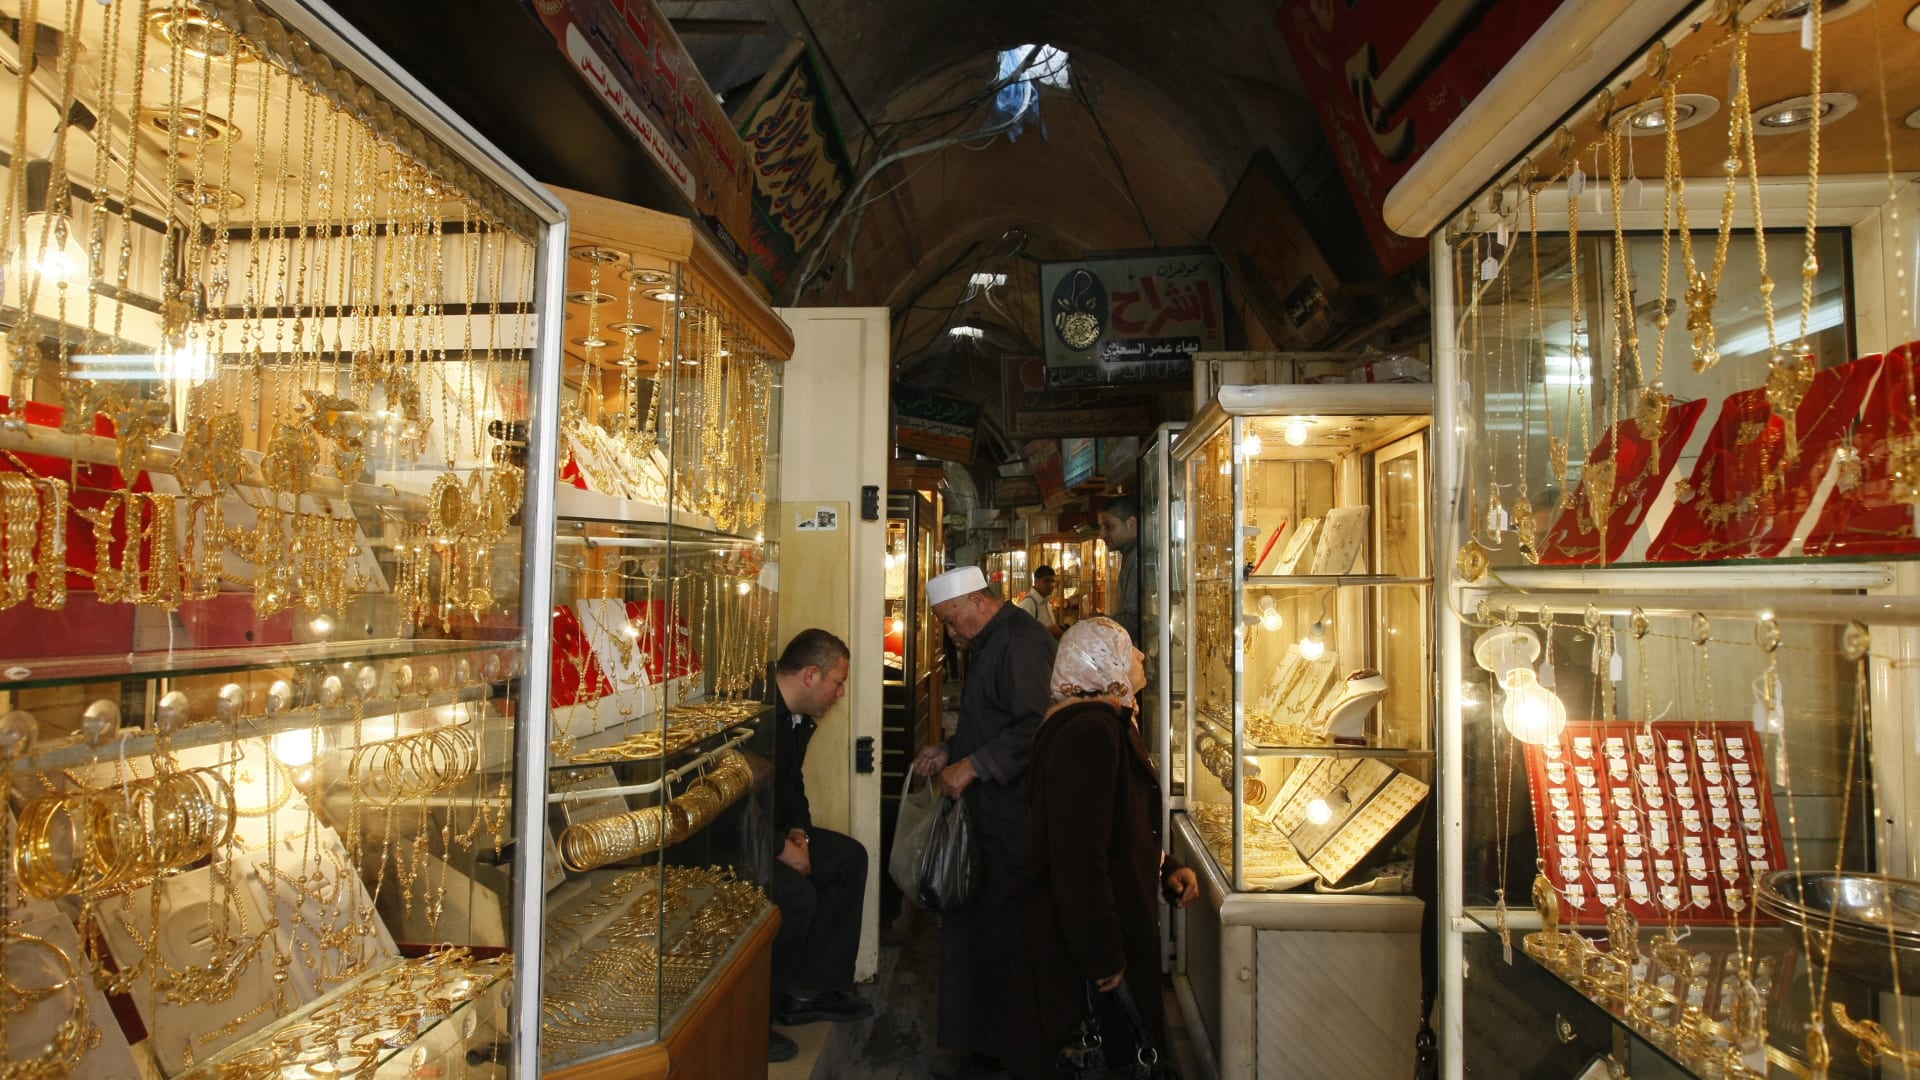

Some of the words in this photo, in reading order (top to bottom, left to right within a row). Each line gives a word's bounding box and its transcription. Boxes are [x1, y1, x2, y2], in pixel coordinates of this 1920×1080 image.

[581, 56, 622, 107] العرائس
[1157, 262, 1201, 277] مجوهرات
[1149, 343, 1172, 357] عمر
[1175, 340, 1199, 356] بهاء
